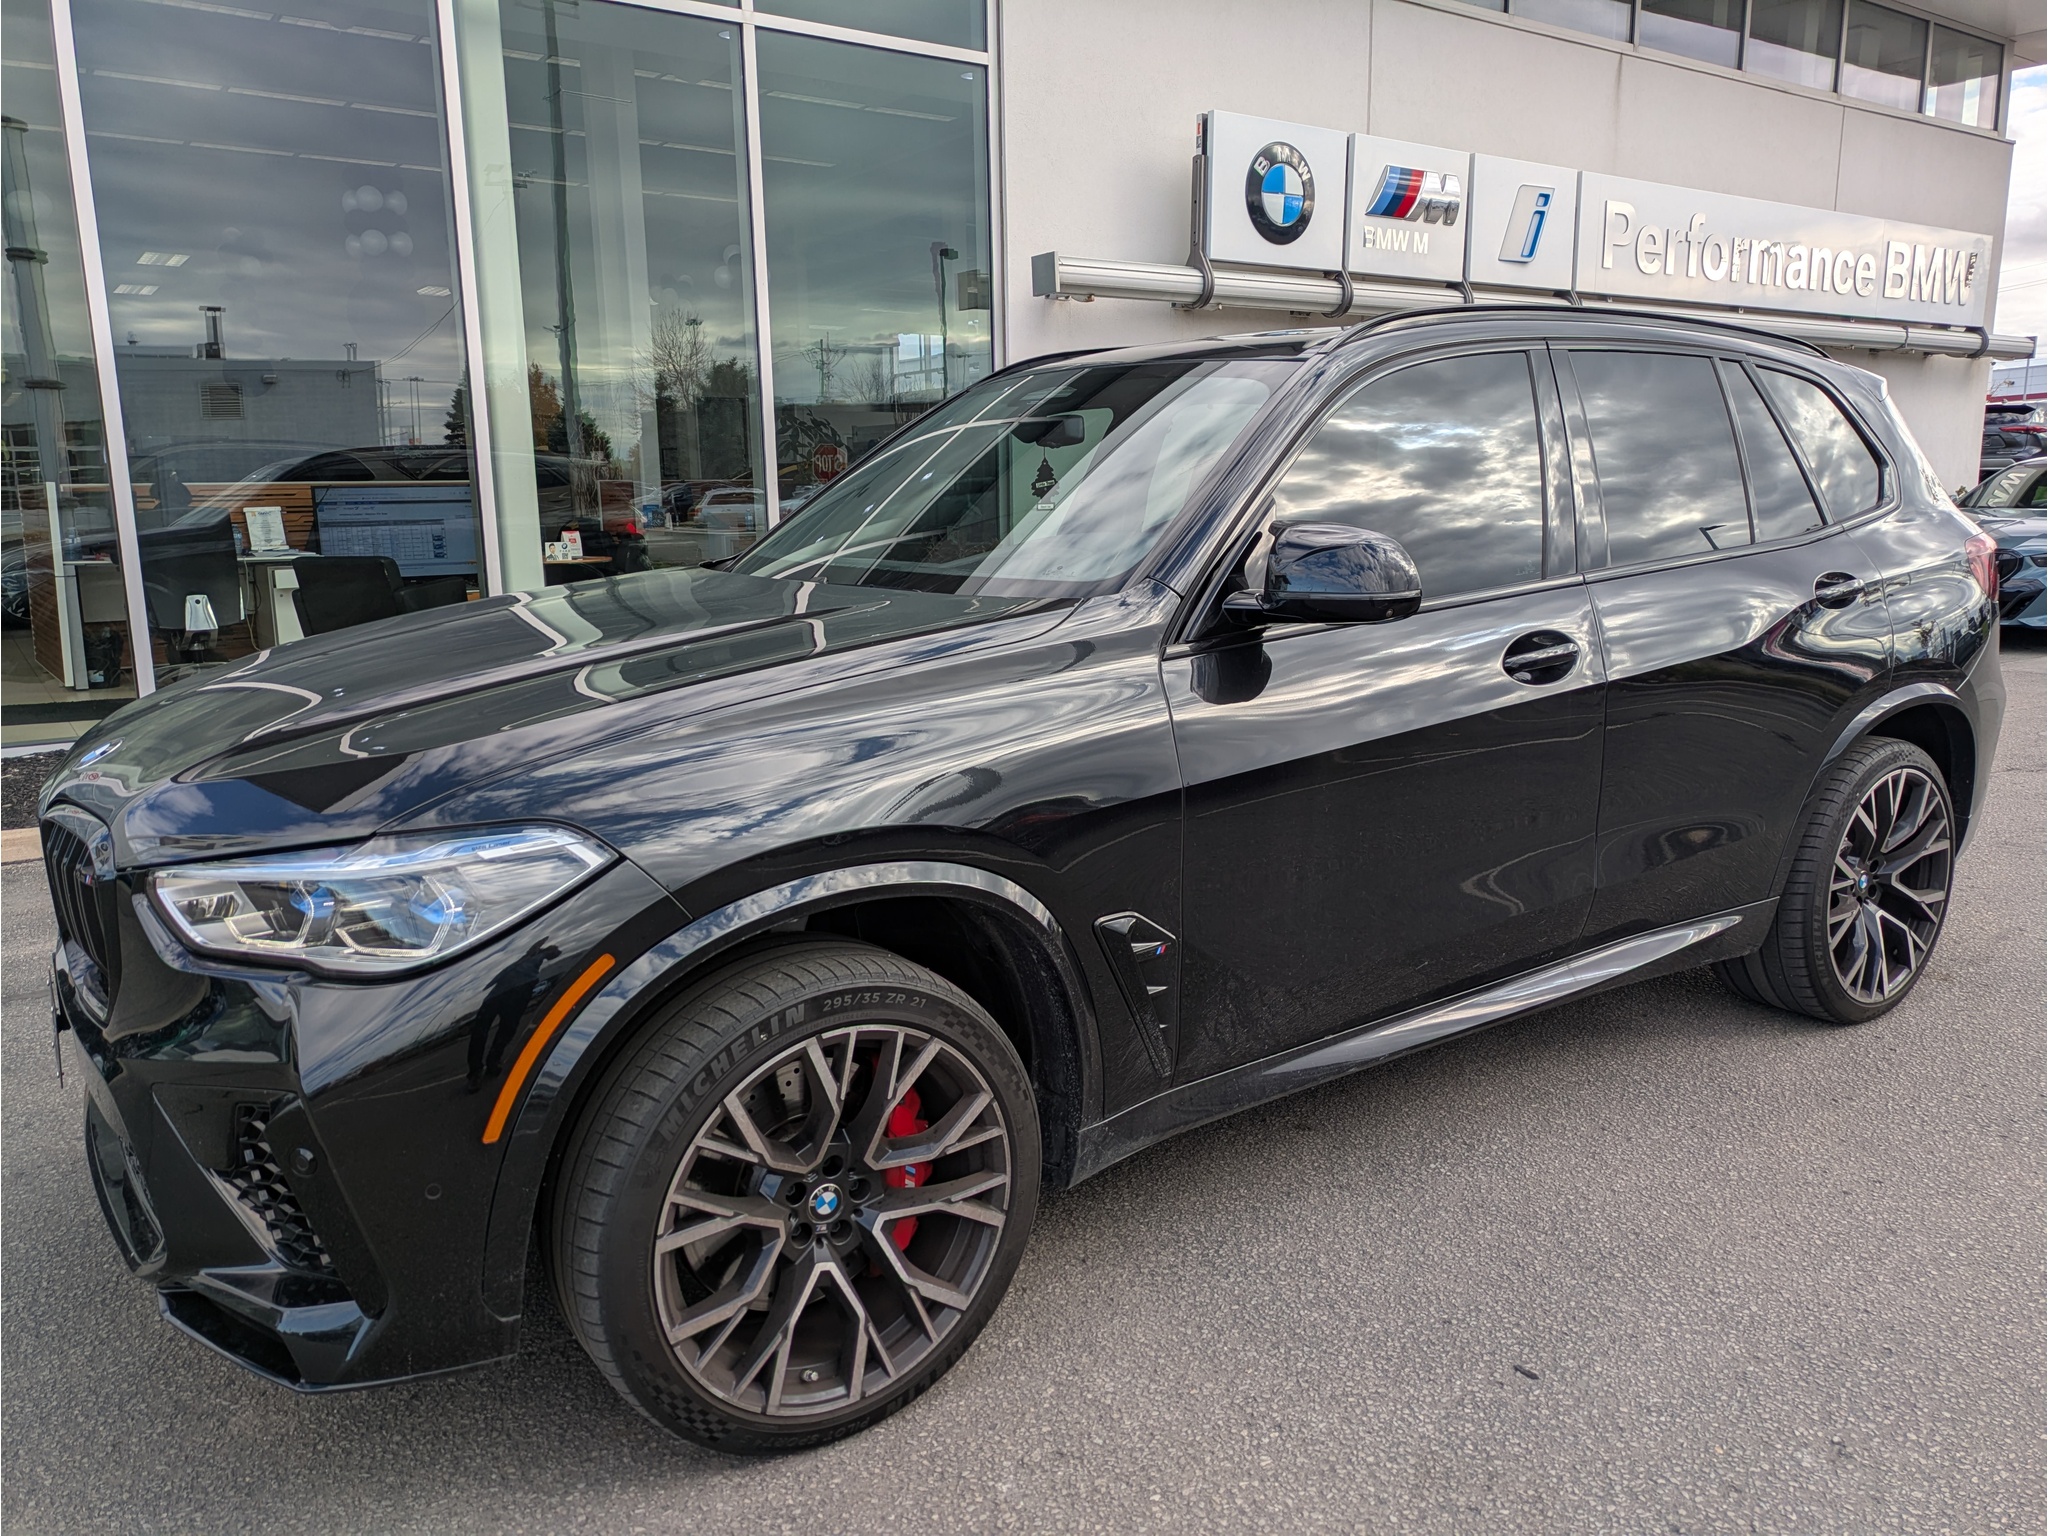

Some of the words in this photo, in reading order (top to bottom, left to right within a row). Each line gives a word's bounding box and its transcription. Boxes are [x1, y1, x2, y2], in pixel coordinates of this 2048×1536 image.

[1253, 146, 1311, 182] BMW
[1363, 225, 1410, 252] BMW
[1413, 231, 1430, 255] M
[1602, 199, 1877, 297] Performance
[1882, 240, 1978, 306] BMW
[822, 992, 881, 1012] 295/35
[884, 992, 906, 1005] ZR
[909, 996, 927, 1008] 21
[658, 1003, 805, 1142] MICHELIN
[763, 1433, 820, 1447] SPORT
[822, 1416, 871, 1442] PILOT
